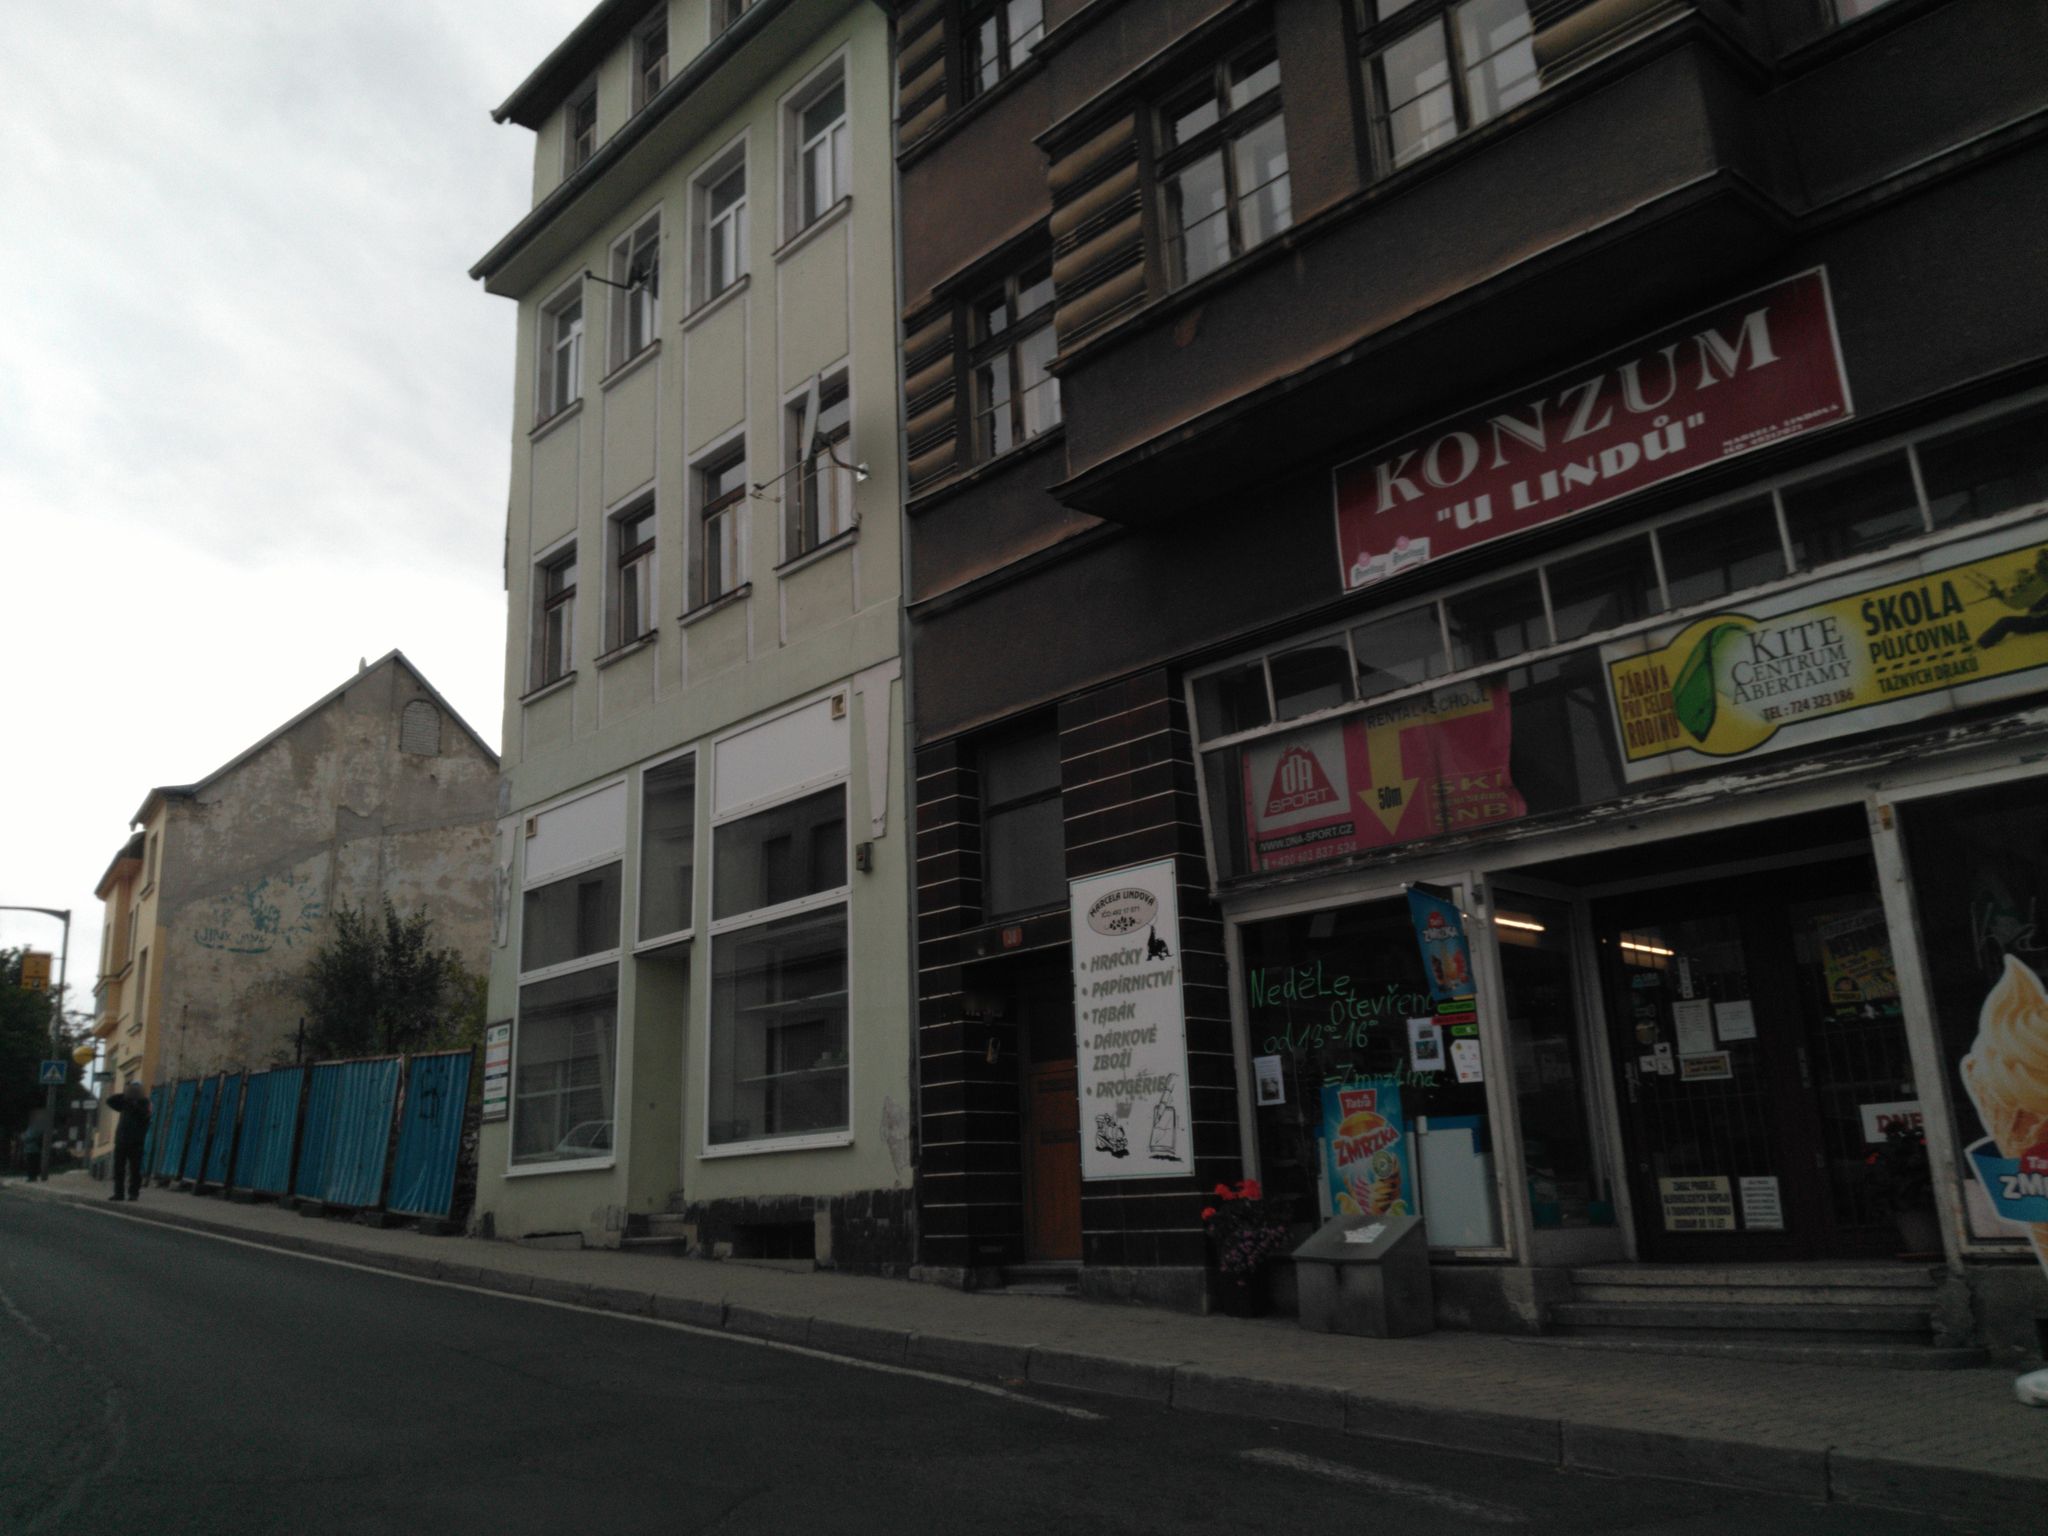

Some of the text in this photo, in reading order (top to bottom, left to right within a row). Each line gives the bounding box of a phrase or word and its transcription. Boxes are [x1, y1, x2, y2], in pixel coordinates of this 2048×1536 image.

[1375, 307, 1782, 515] KONZUM
[1862, 580, 1964, 636] ŠKOLA
[1748, 616, 1844, 665] KITE
[1870, 619, 1971, 664] PŮJČOVNA
[1731, 643, 1849, 687] CENTRUM
[1732, 660, 1852, 706] ABERTAMY
[1790, 699, 1811, 713] 724
[1813, 695, 1833, 709] 323
[1376, 785, 1403, 811] 50m
[1430, 773, 1504, 796] SKI
[1268, 786, 1330, 815] SPORT
[1090, 947, 1144, 973] HRAČKY
[1091, 965, 1176, 998] PAPÍRNICTVÍ
[1091, 1000, 1137, 1026] TABÁK
[1093, 1024, 1159, 1050] DÁRKOVÉ
[1092, 1048, 1134, 1071] ZBOŽÍ
[1333, 1125, 1400, 1167] ZMRZKA
